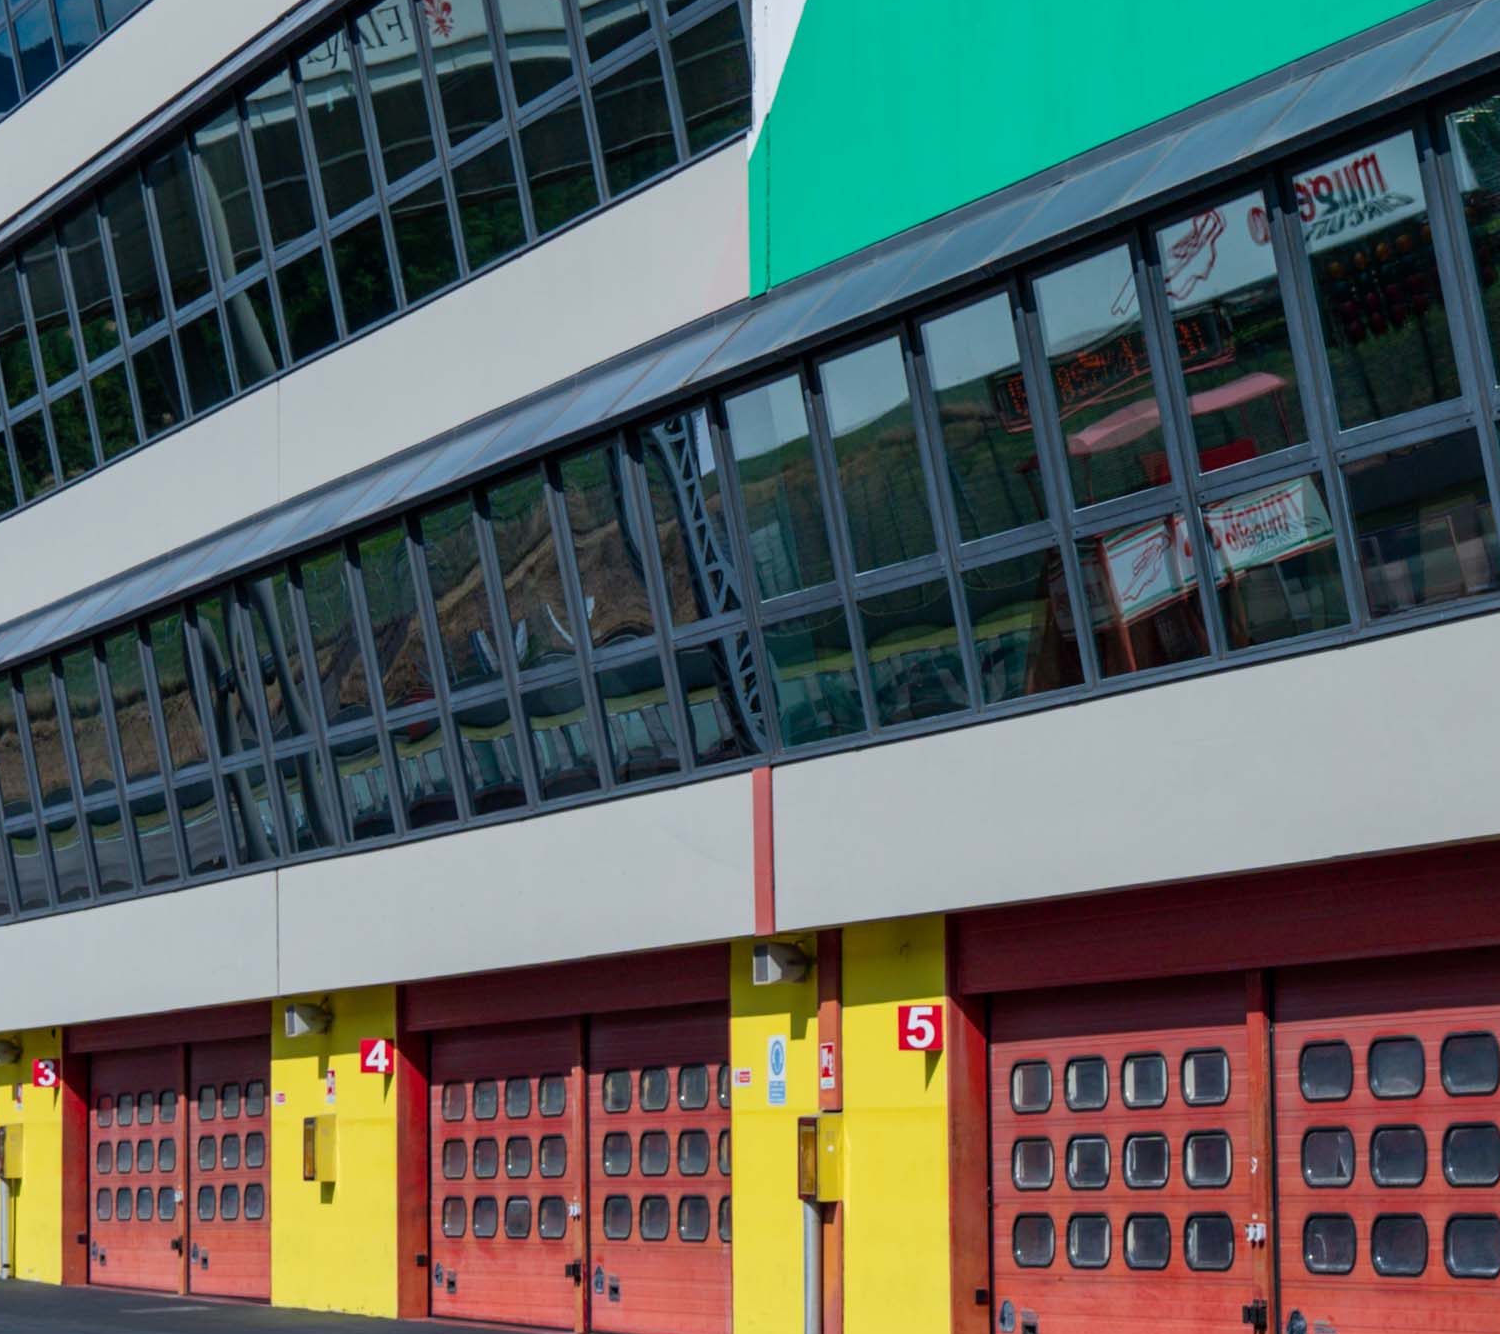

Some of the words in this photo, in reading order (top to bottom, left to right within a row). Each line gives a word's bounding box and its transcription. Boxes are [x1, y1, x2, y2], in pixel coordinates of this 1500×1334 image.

[906, 1007, 935, 1047] 5
[365, 1039, 390, 1072] 4
[38, 1060, 56, 1086] 3
